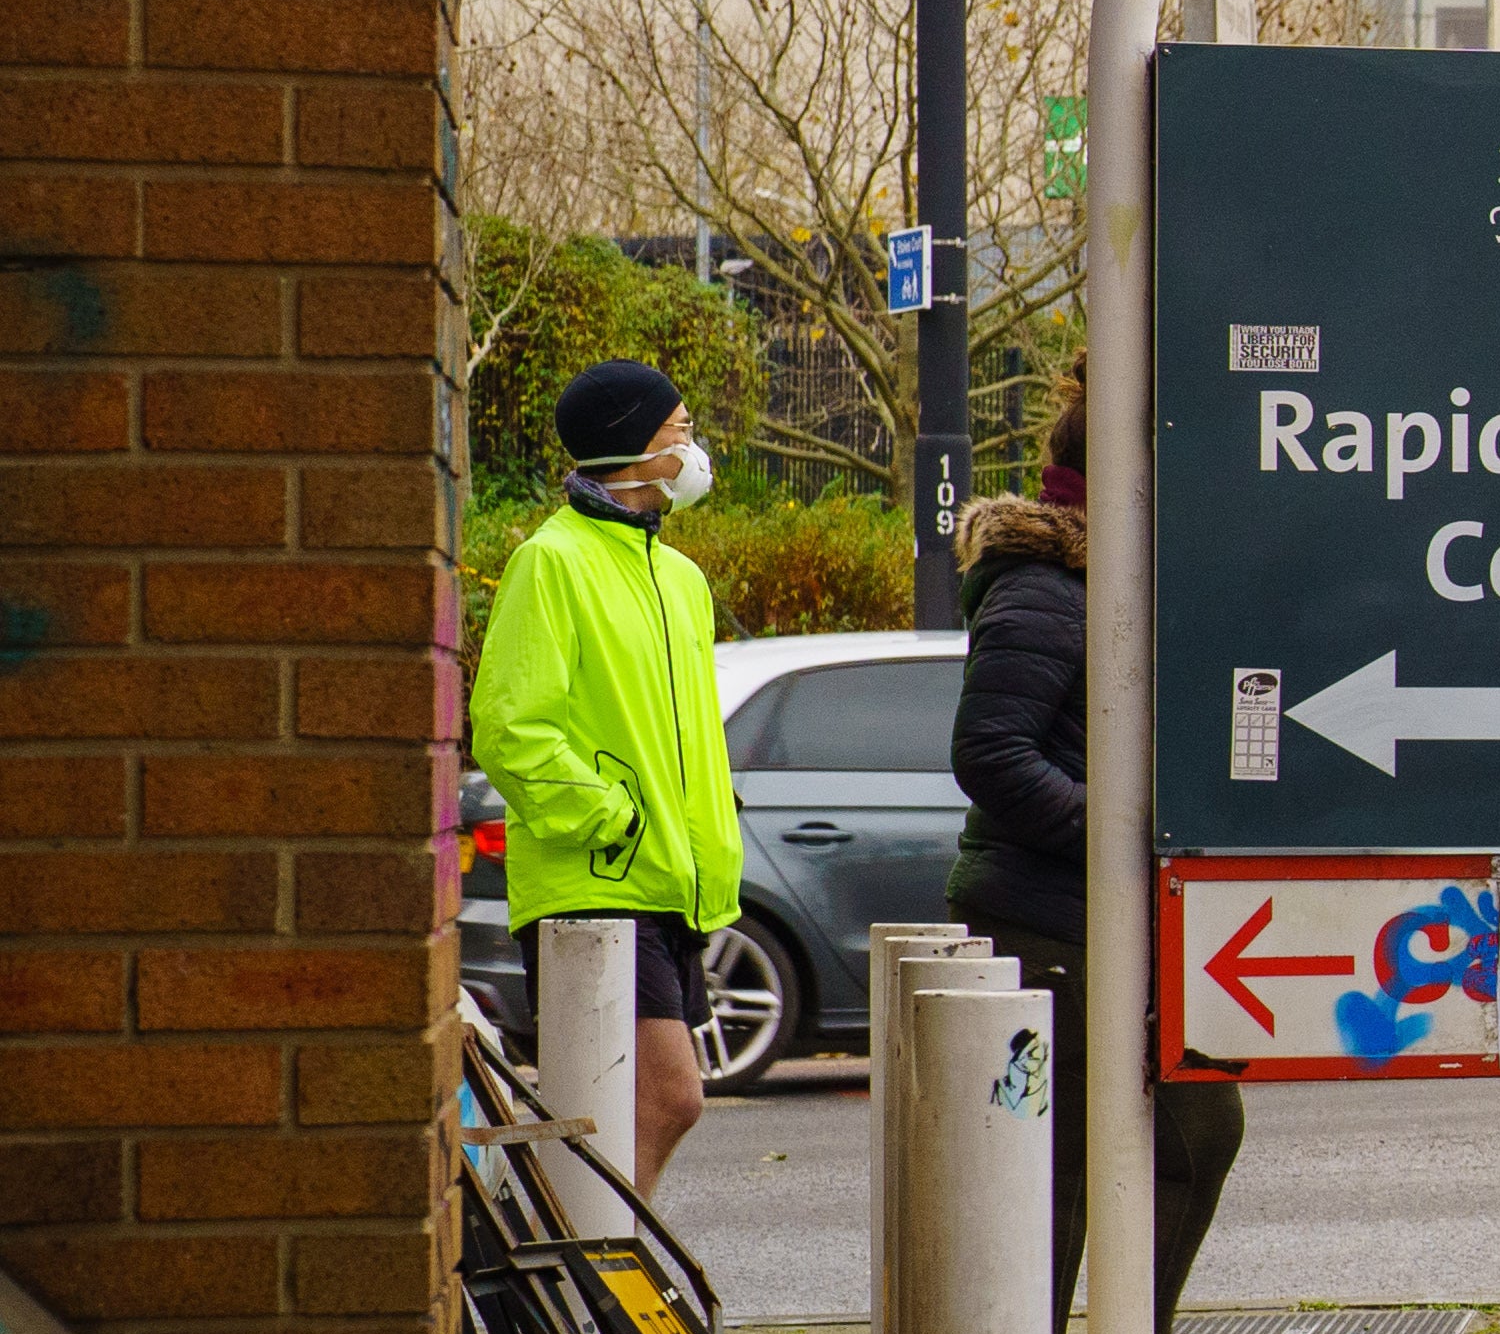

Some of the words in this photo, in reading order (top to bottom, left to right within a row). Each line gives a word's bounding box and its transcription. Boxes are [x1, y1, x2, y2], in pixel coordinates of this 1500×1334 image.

[1240, 325, 1268, 334] WHEN
[1269, 325, 1286, 334] YOU
[1288, 326, 1316, 335] TRADE
[1240, 334, 1290, 345] LIBERTY
[1293, 335, 1315, 345] FOR
[1240, 346, 1315, 359] SECURITY
[1240, 359, 1260, 368] YOU
[1261, 359, 1287, 369] LOSE
[1289, 360, 1316, 369] BOTH
[937, 454, 955, 535] 109
